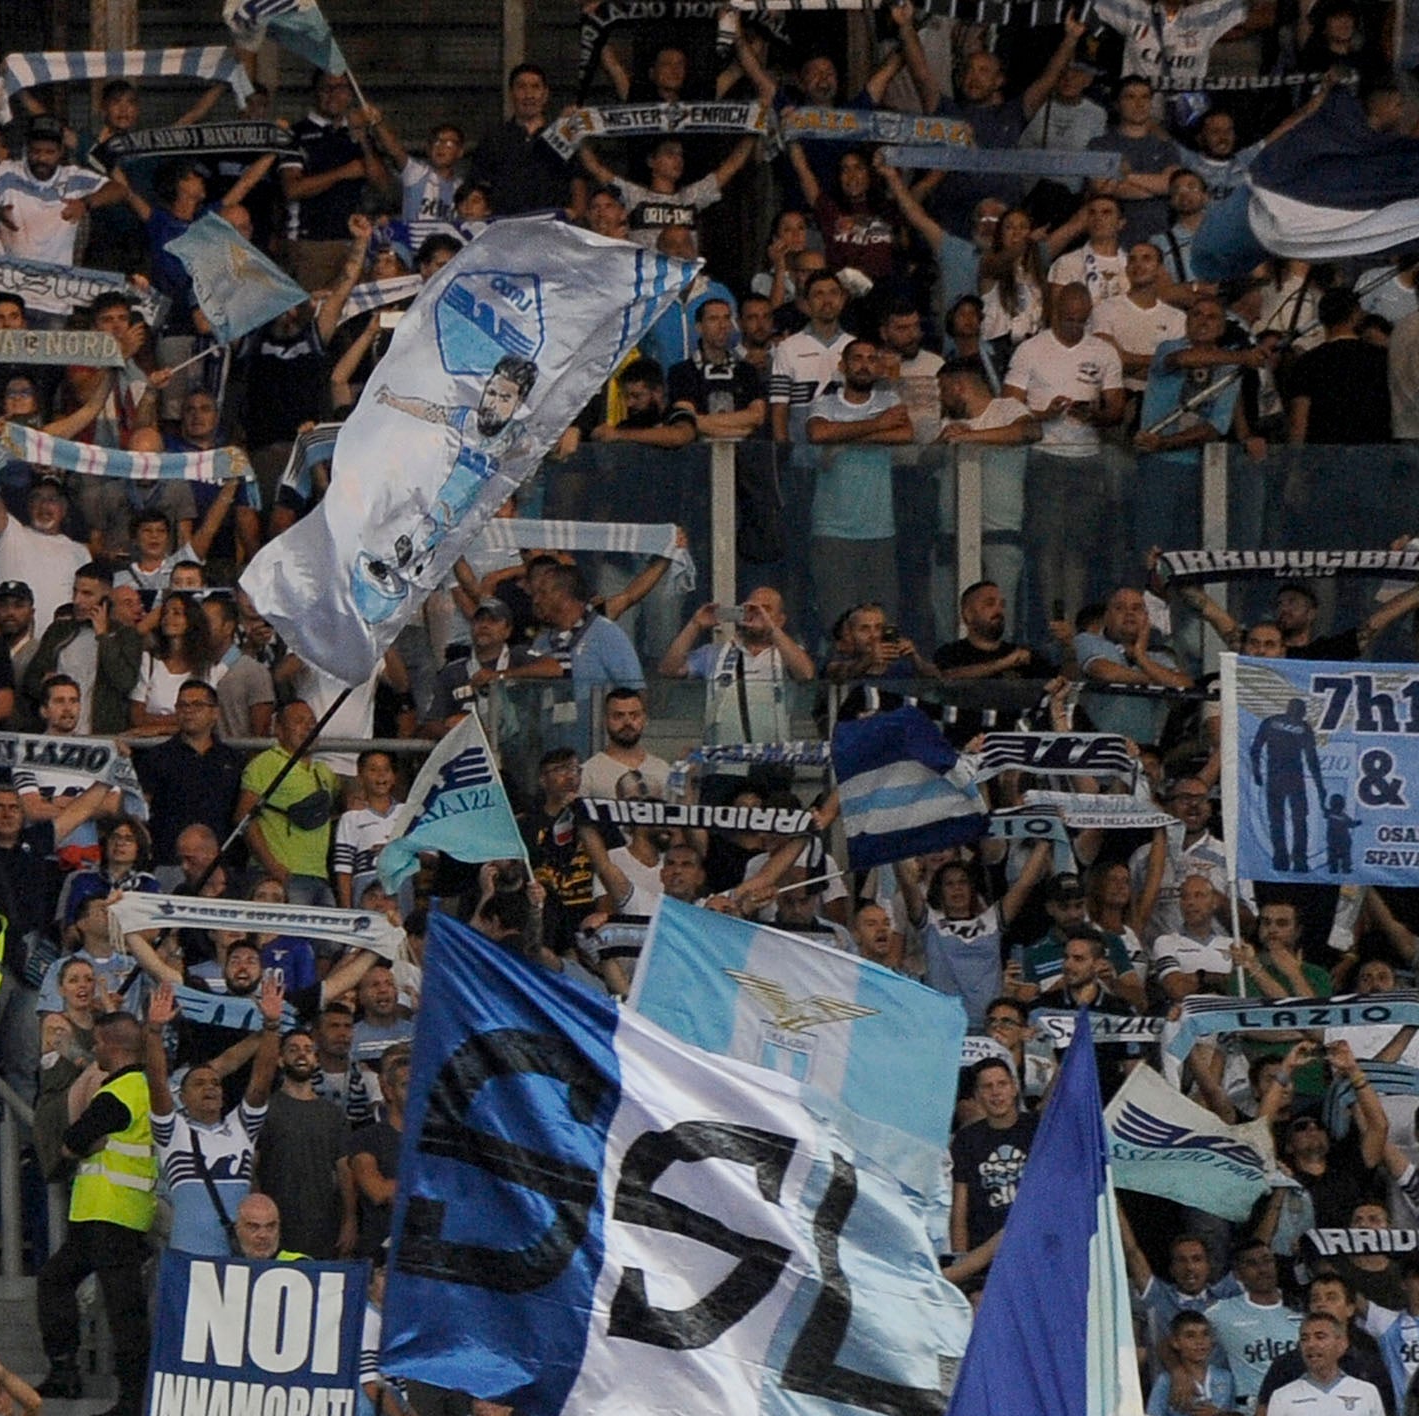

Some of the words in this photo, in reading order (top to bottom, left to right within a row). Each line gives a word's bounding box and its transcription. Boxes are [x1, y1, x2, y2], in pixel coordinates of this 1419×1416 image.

[45, 331, 117, 358] NORD
[23, 738, 112, 774] LAZIO
[1357, 747, 1408, 808] &
[1237, 1005, 1392, 1028] LAZIO
[180, 1259, 346, 1375] NOI
